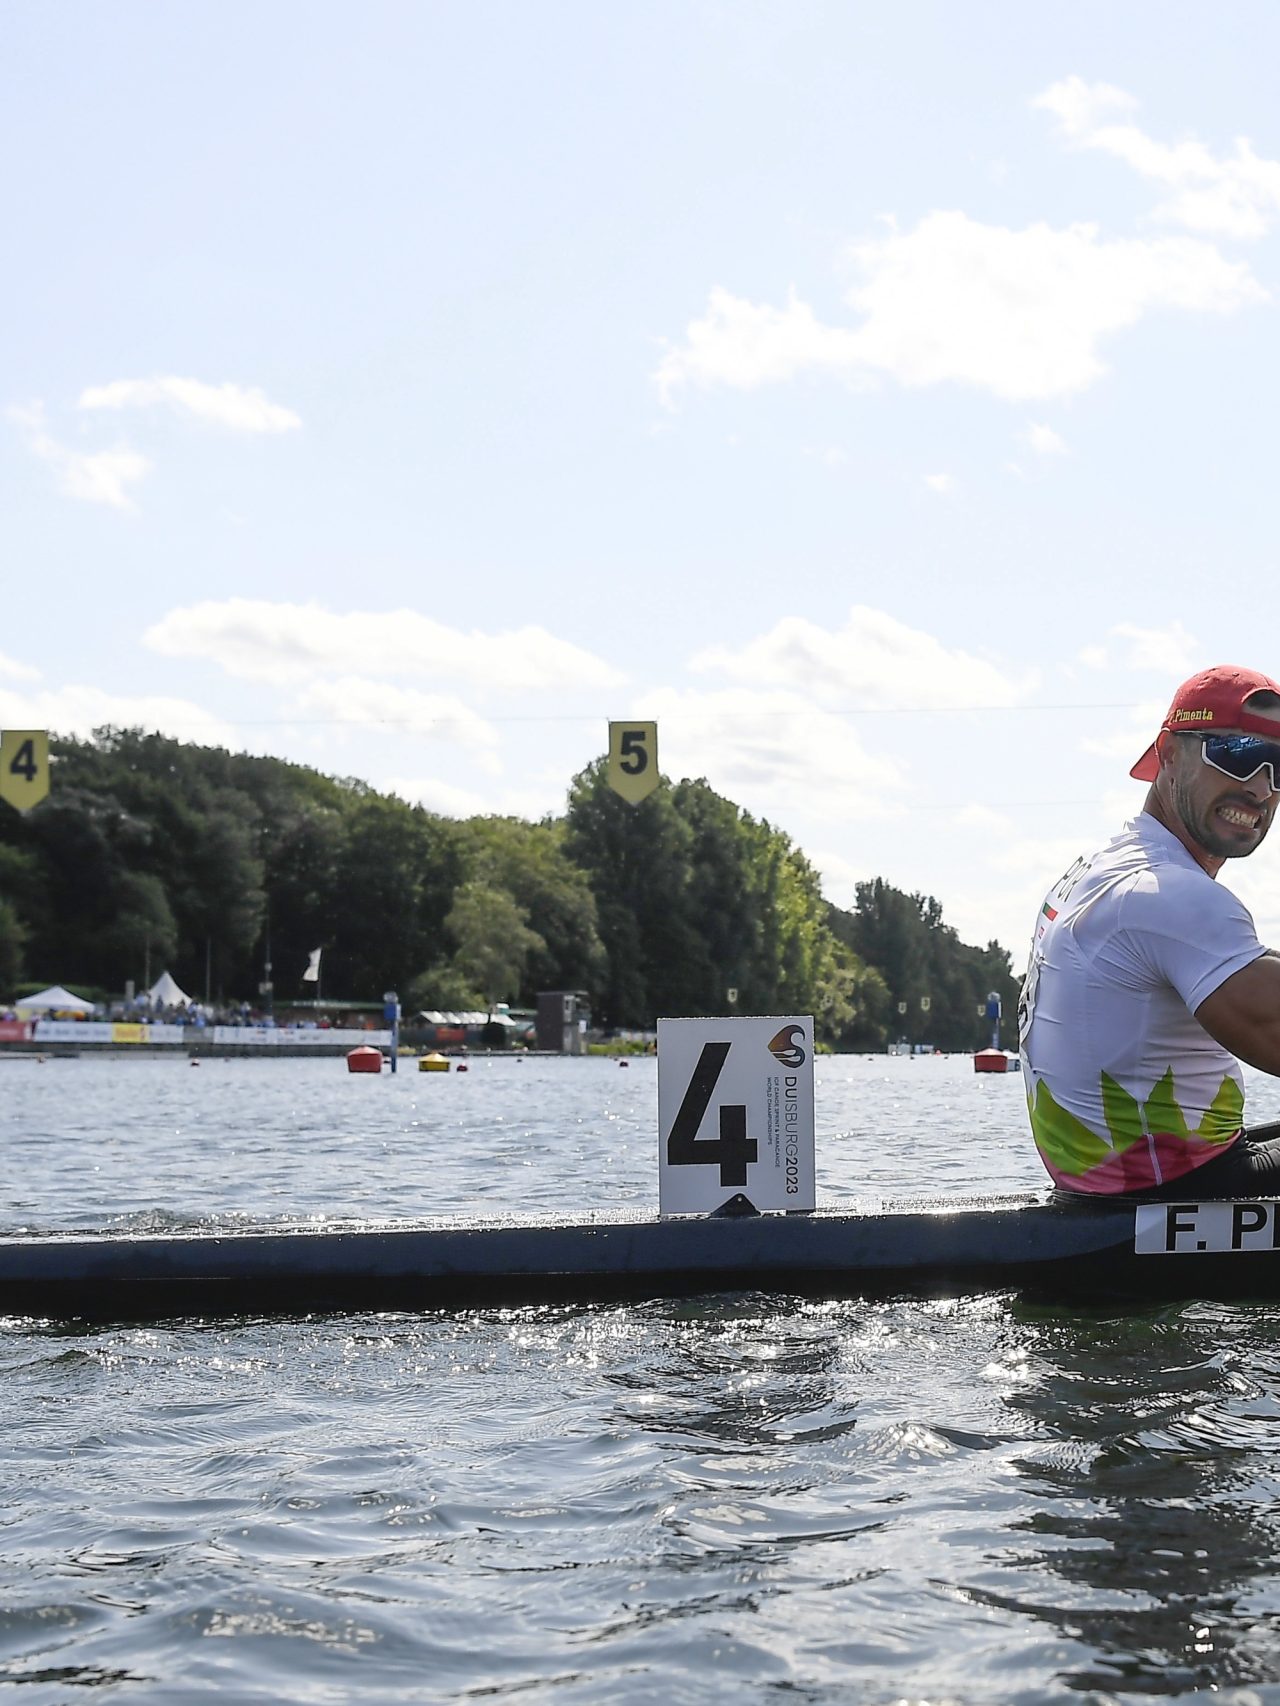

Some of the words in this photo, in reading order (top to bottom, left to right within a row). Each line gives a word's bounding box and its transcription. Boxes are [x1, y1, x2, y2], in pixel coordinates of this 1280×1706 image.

[10, 739, 37, 782] 4
[620, 731, 648, 775] 5
[667, 1042, 758, 1187] 4
[784, 1076, 799, 1195] DUISBURG2023
[1165, 1205, 1206, 1251] F.
